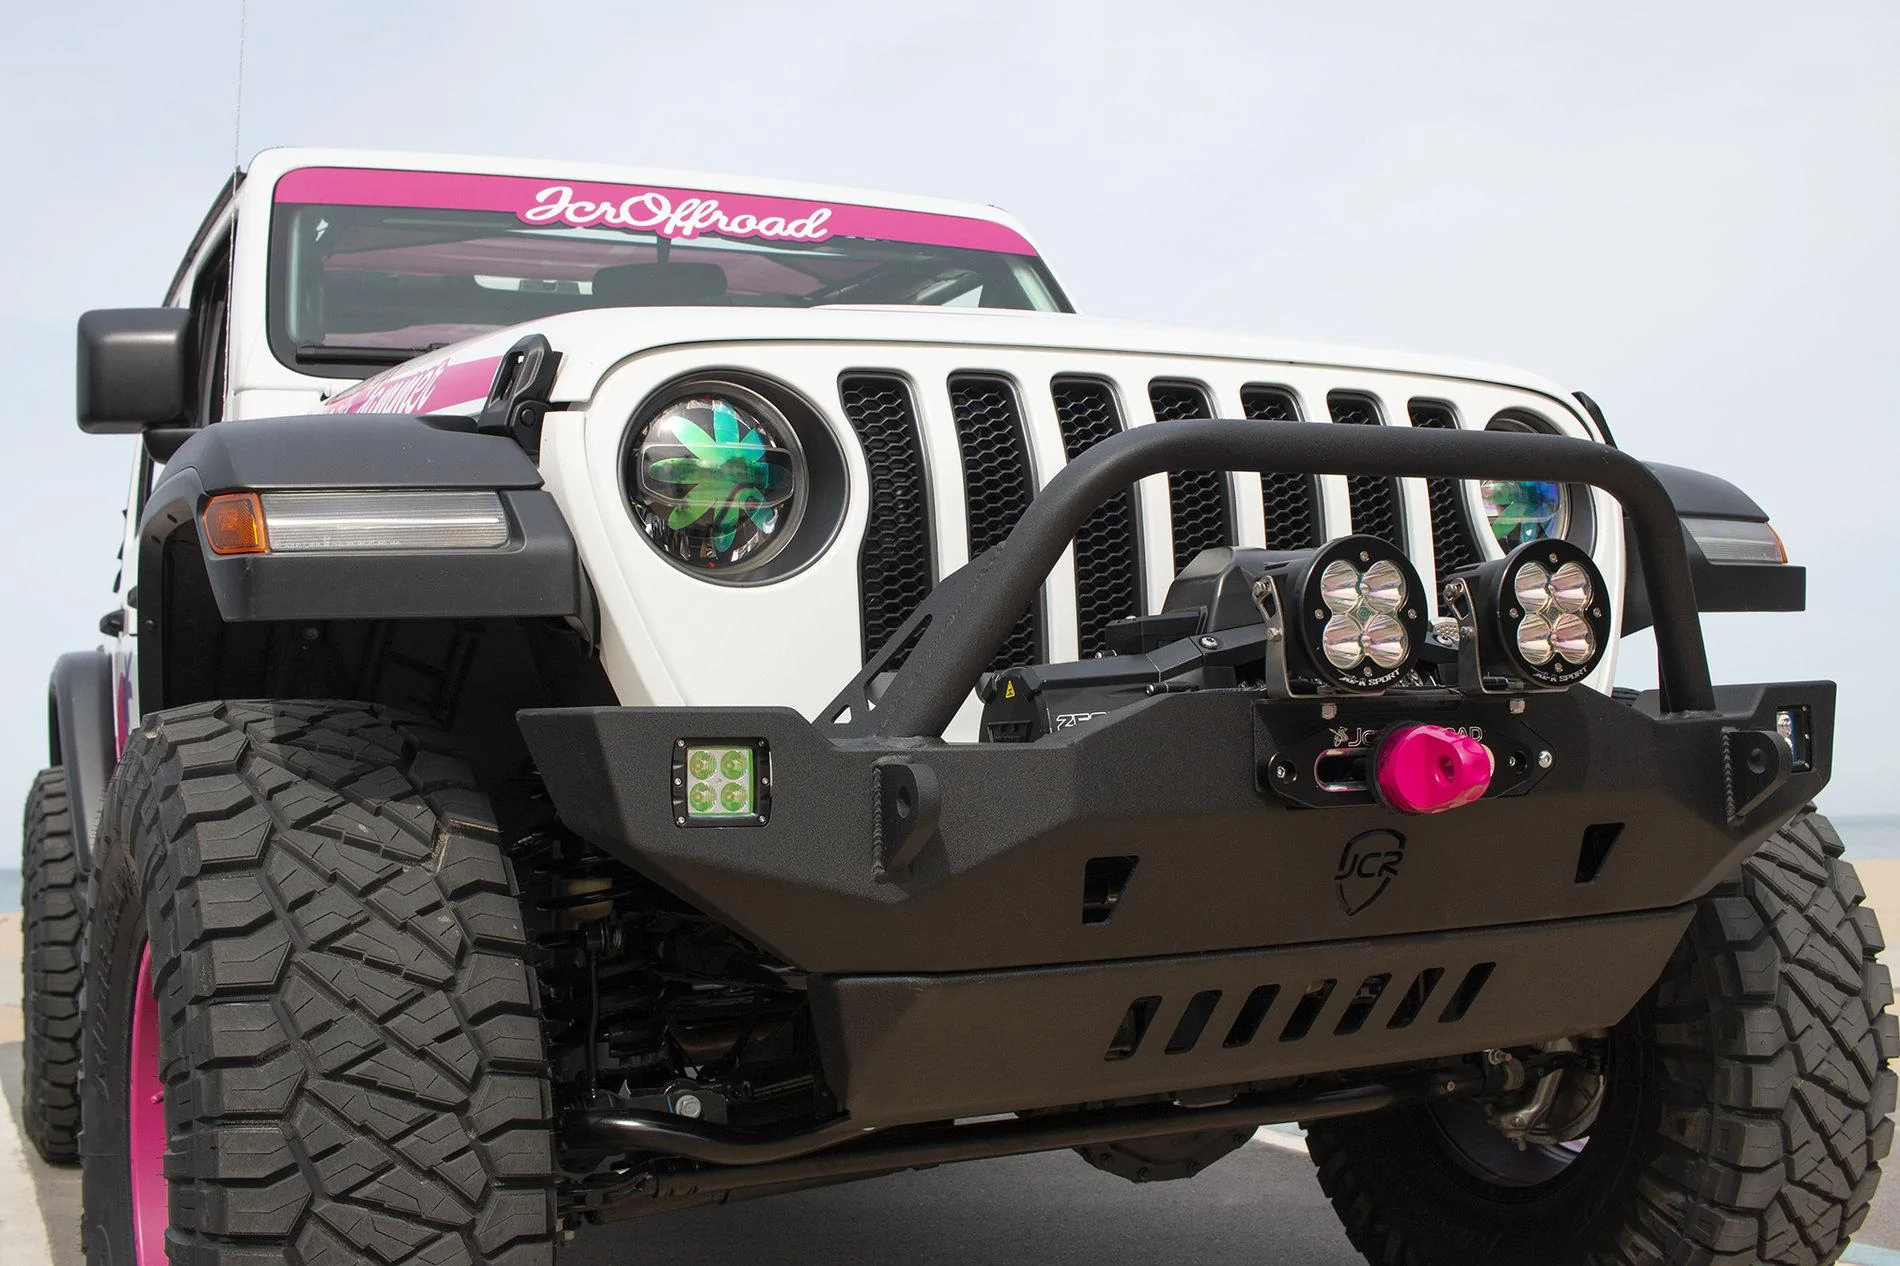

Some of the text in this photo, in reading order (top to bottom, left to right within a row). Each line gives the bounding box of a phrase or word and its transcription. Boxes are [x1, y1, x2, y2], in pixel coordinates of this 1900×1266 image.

[525, 186, 832, 239] JcrOffroad
[1368, 668, 1400, 686] SPORT
[1559, 665, 1587, 682] SPORT
[1334, 850, 1403, 880] JCR
